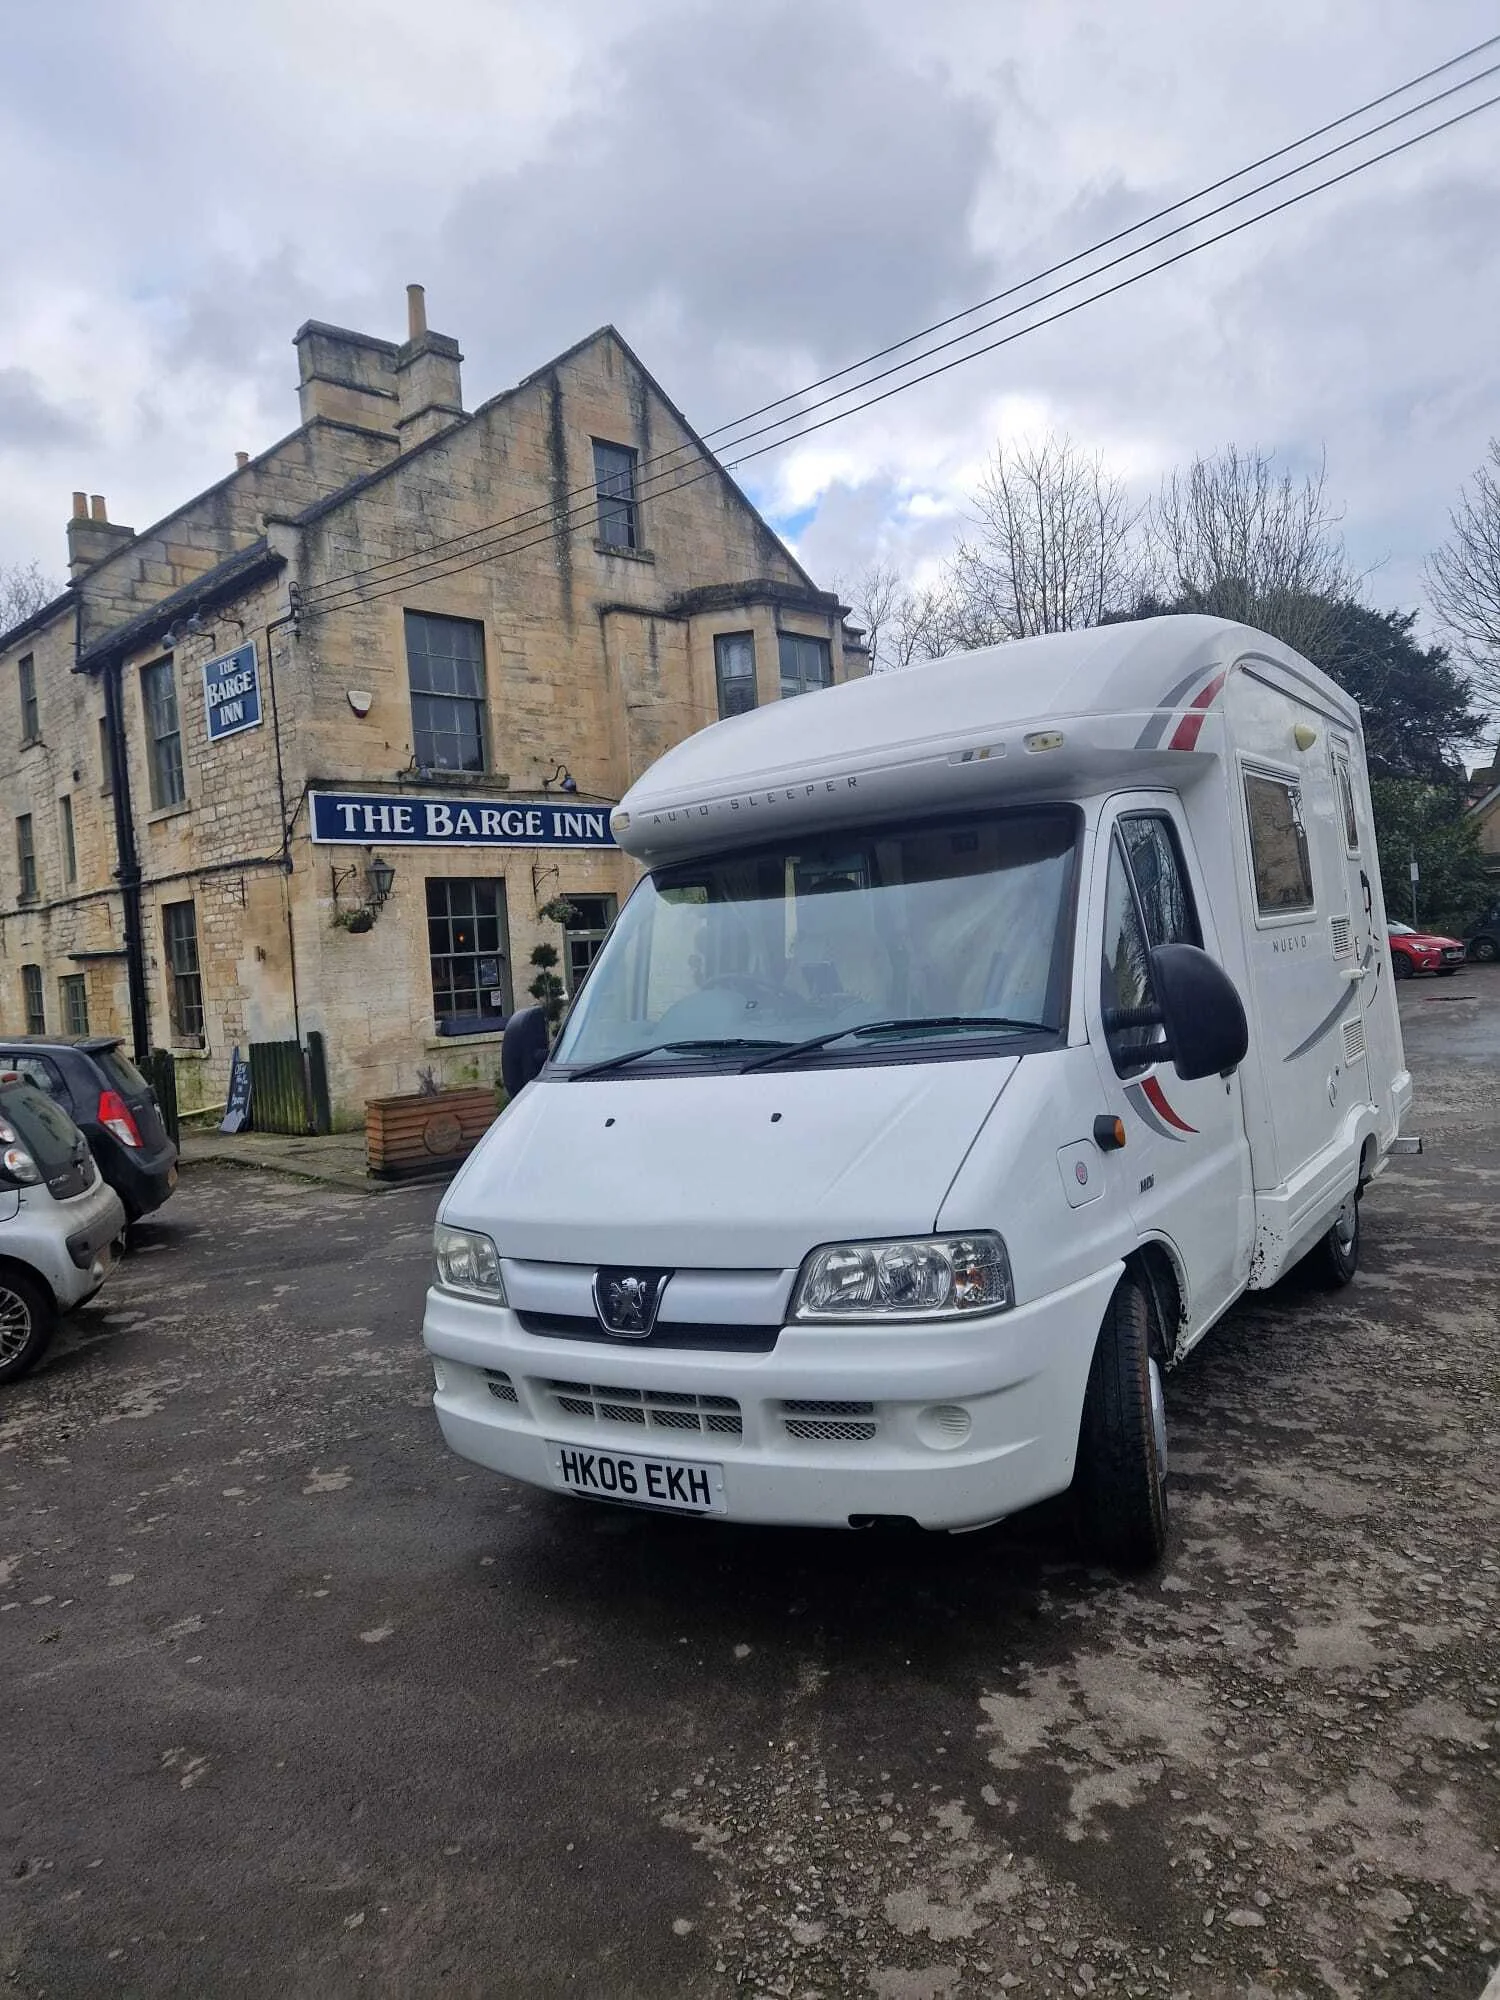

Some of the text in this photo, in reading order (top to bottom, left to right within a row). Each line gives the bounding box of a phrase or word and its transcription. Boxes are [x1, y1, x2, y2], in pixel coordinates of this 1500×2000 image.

[218, 657, 238, 676] THE
[207, 670, 254, 707] BARGE
[220, 700, 244, 726] INN
[336, 803, 604, 838] THE BARGE INN
[1272, 935, 1307, 953] NUEVO
[561, 1449, 711, 1505] HK06 EKH
